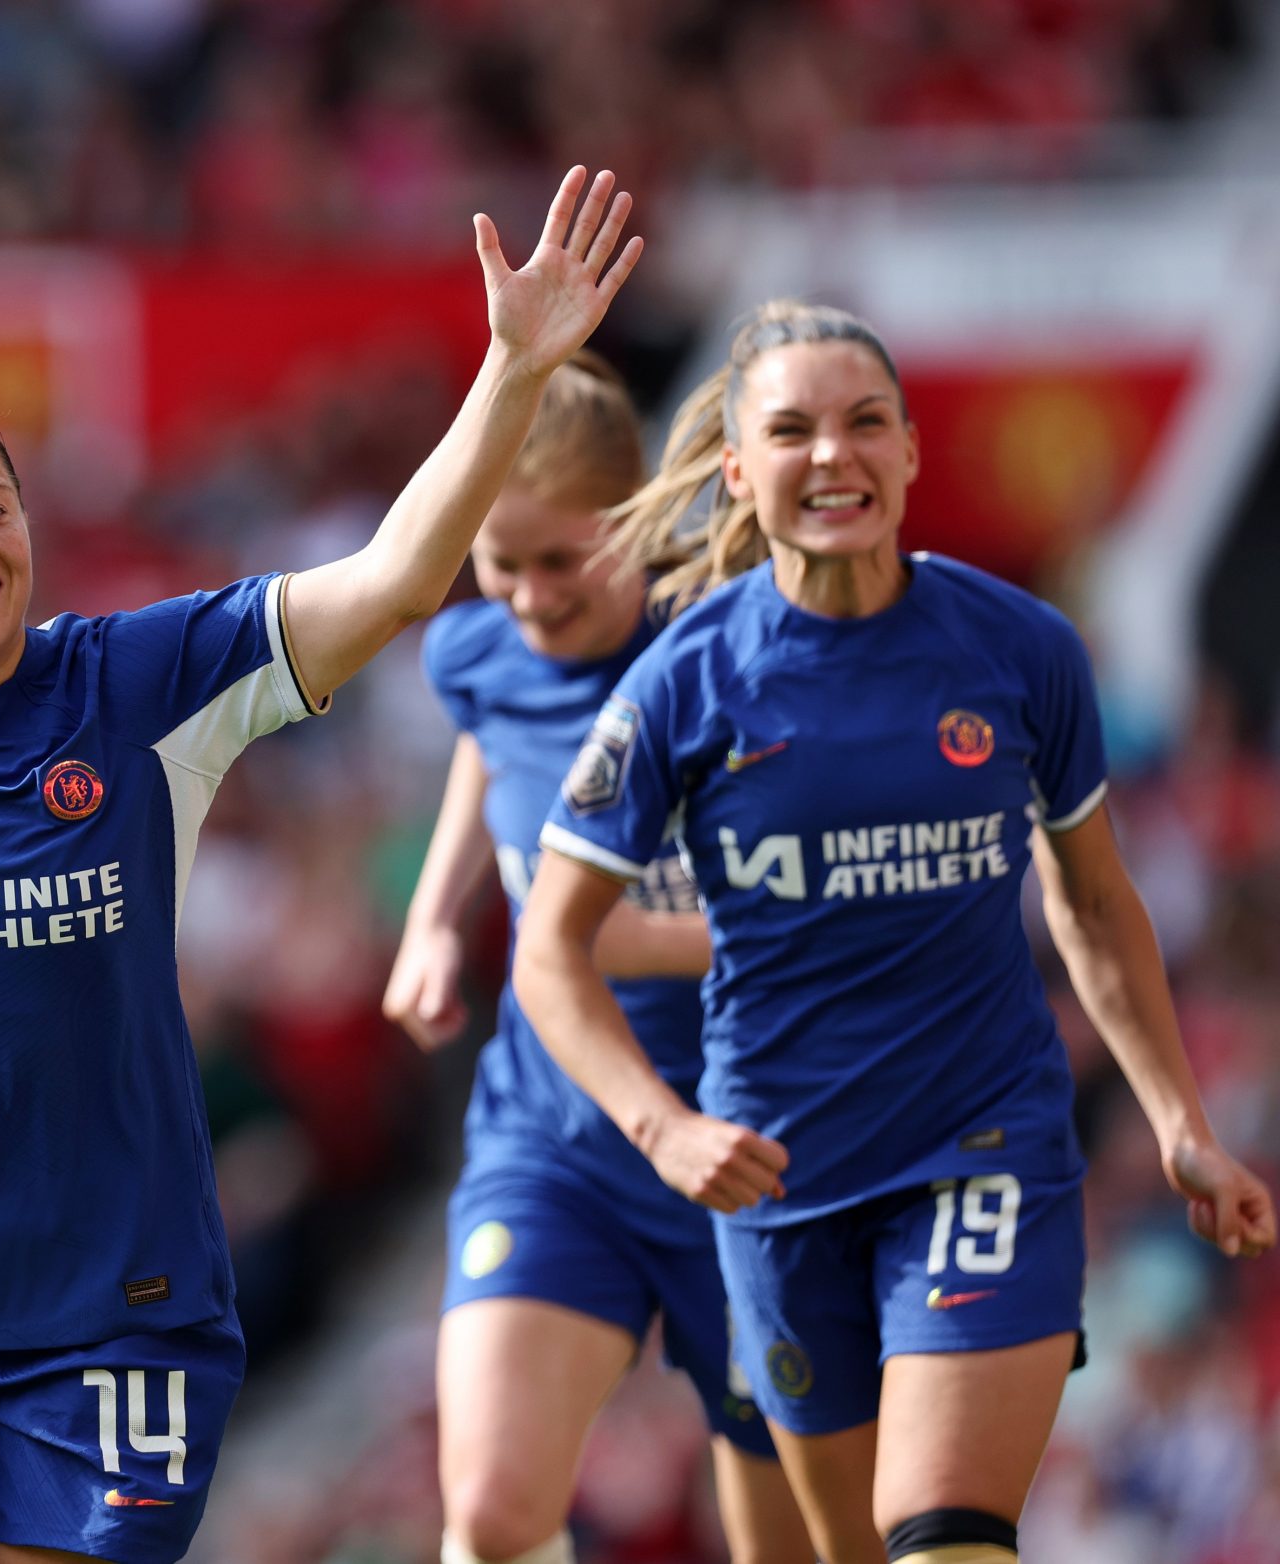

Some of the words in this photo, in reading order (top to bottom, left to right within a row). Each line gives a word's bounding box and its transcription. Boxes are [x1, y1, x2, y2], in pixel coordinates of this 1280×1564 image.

[823, 812, 1004, 862] INFINITE
[824, 847, 1009, 898] ATHLETE
[927, 1174, 1021, 1275] 19
[83, 1369, 187, 1485] 14
